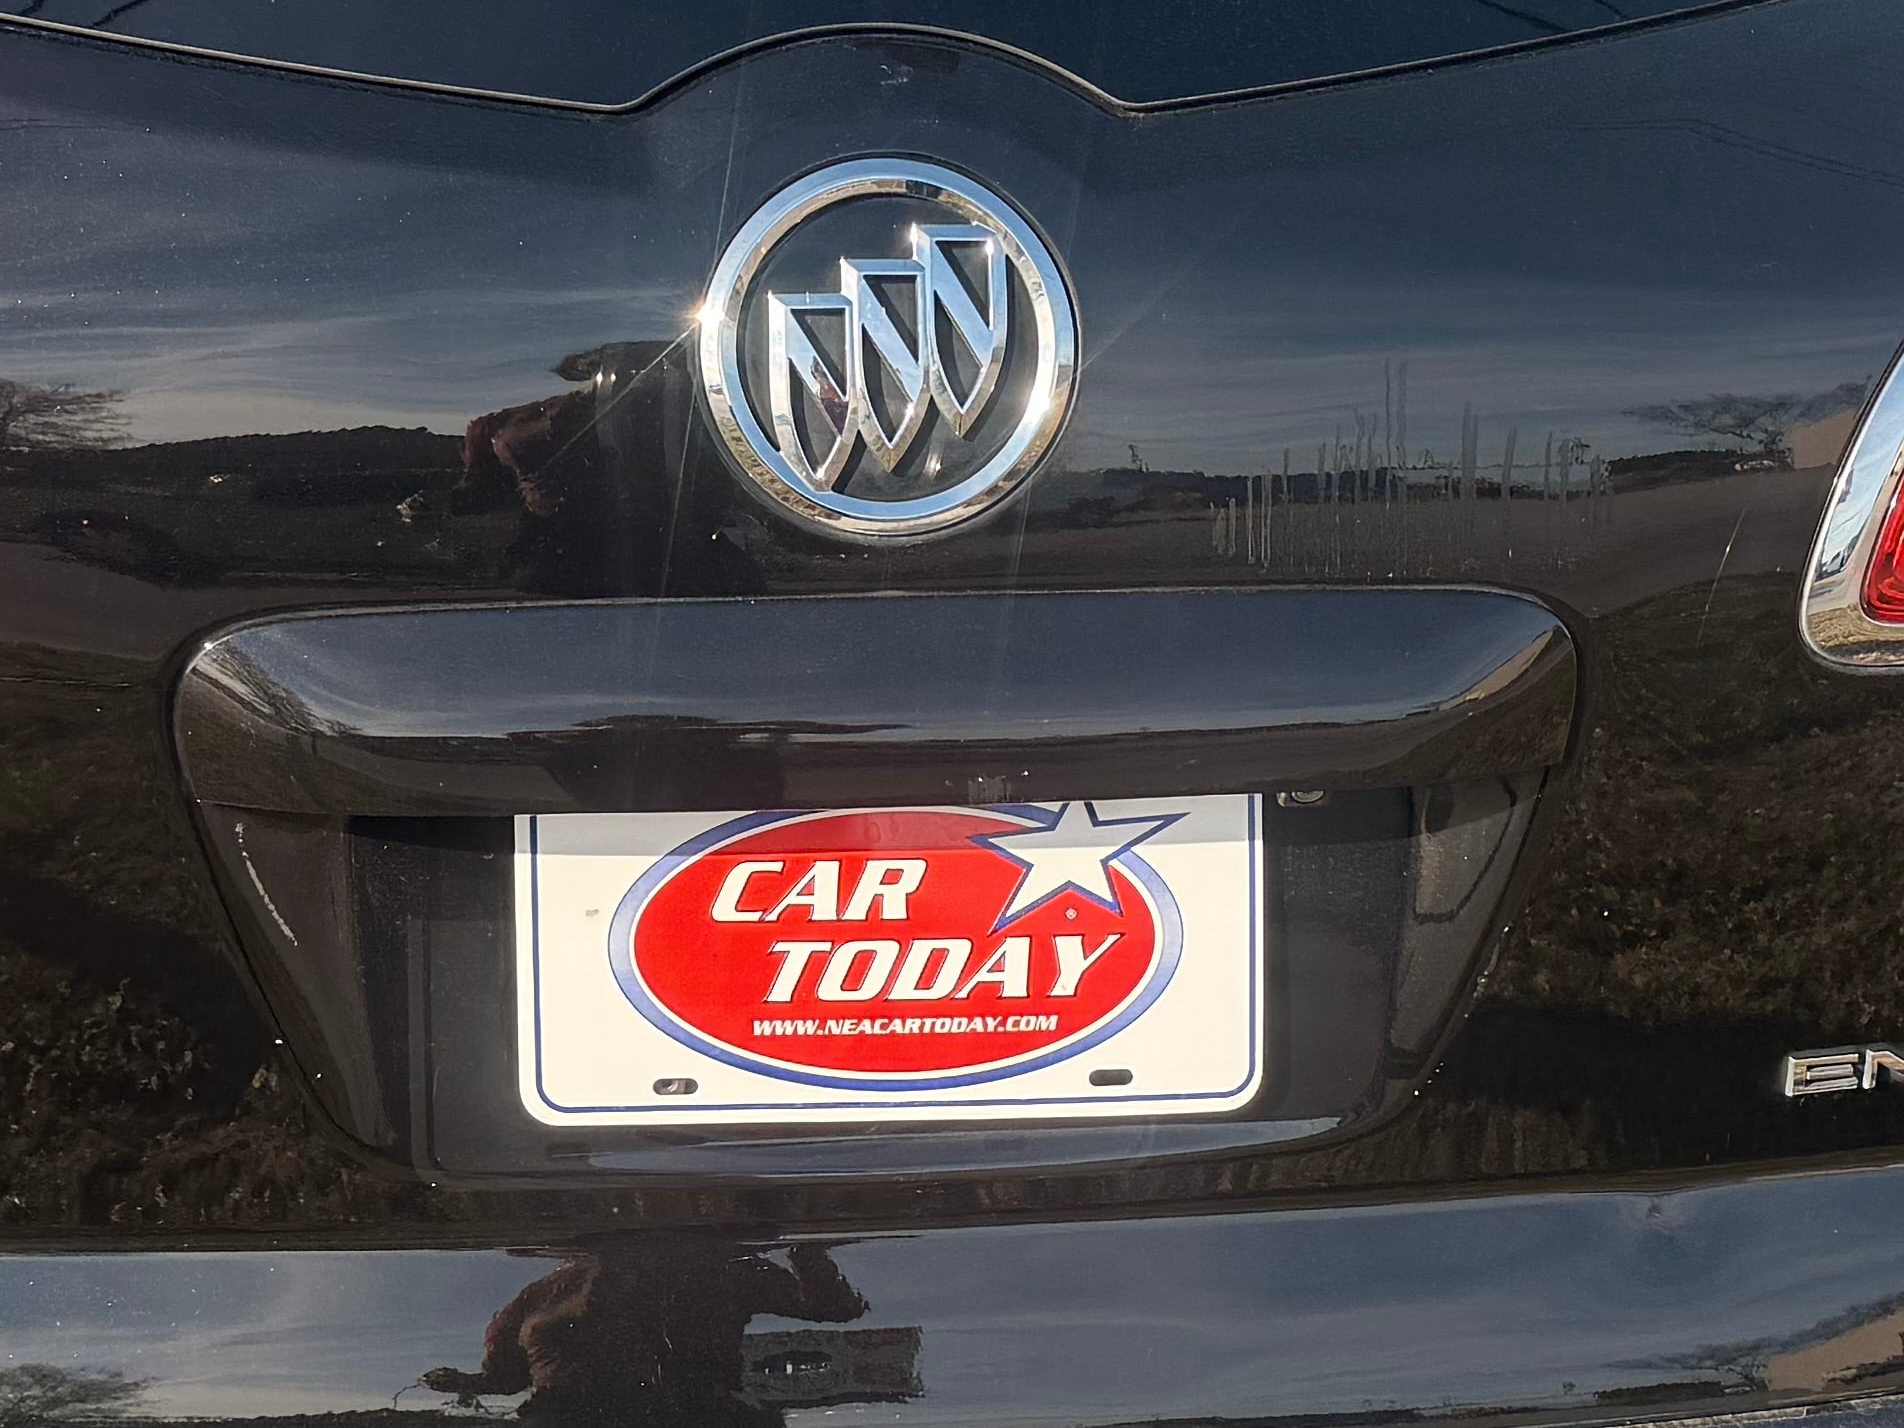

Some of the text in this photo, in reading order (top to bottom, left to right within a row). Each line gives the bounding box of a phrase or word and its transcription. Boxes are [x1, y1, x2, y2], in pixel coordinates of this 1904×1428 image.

[710, 859, 927, 923] CAR
[762, 933, 1123, 1003] TODAY
[752, 1015, 1059, 1036] WWW.NEACARTODAY.COM
